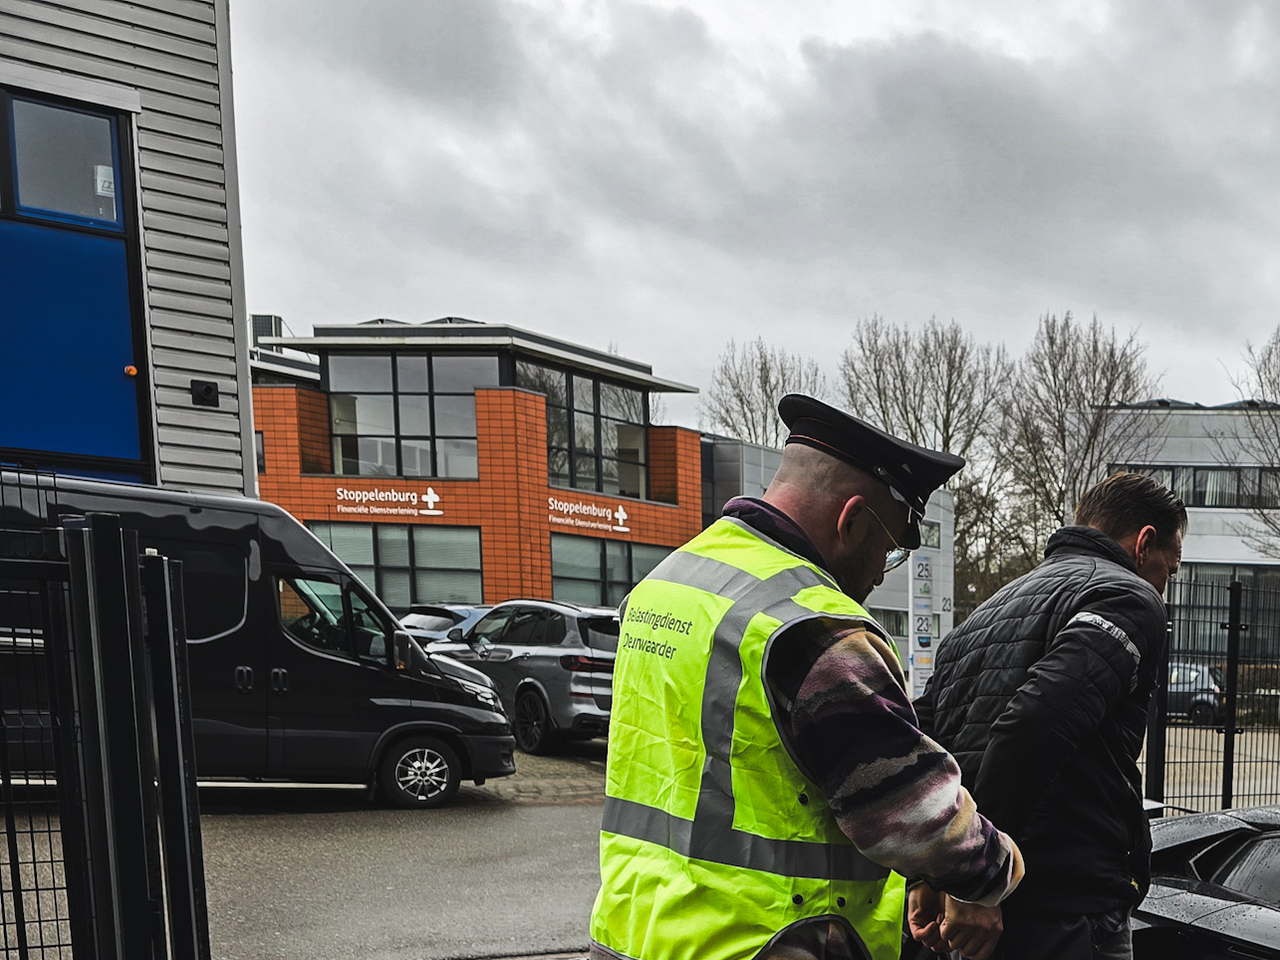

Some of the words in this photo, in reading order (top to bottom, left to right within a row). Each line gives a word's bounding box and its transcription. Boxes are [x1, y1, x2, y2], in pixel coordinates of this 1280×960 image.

[336, 487, 418, 505] Stoppelenburg
[548, 497, 612, 521] Stoppelenburg
[917, 562, 930, 579] 25
[941, 597, 952, 612] 23
[916, 617, 929, 632] 23
